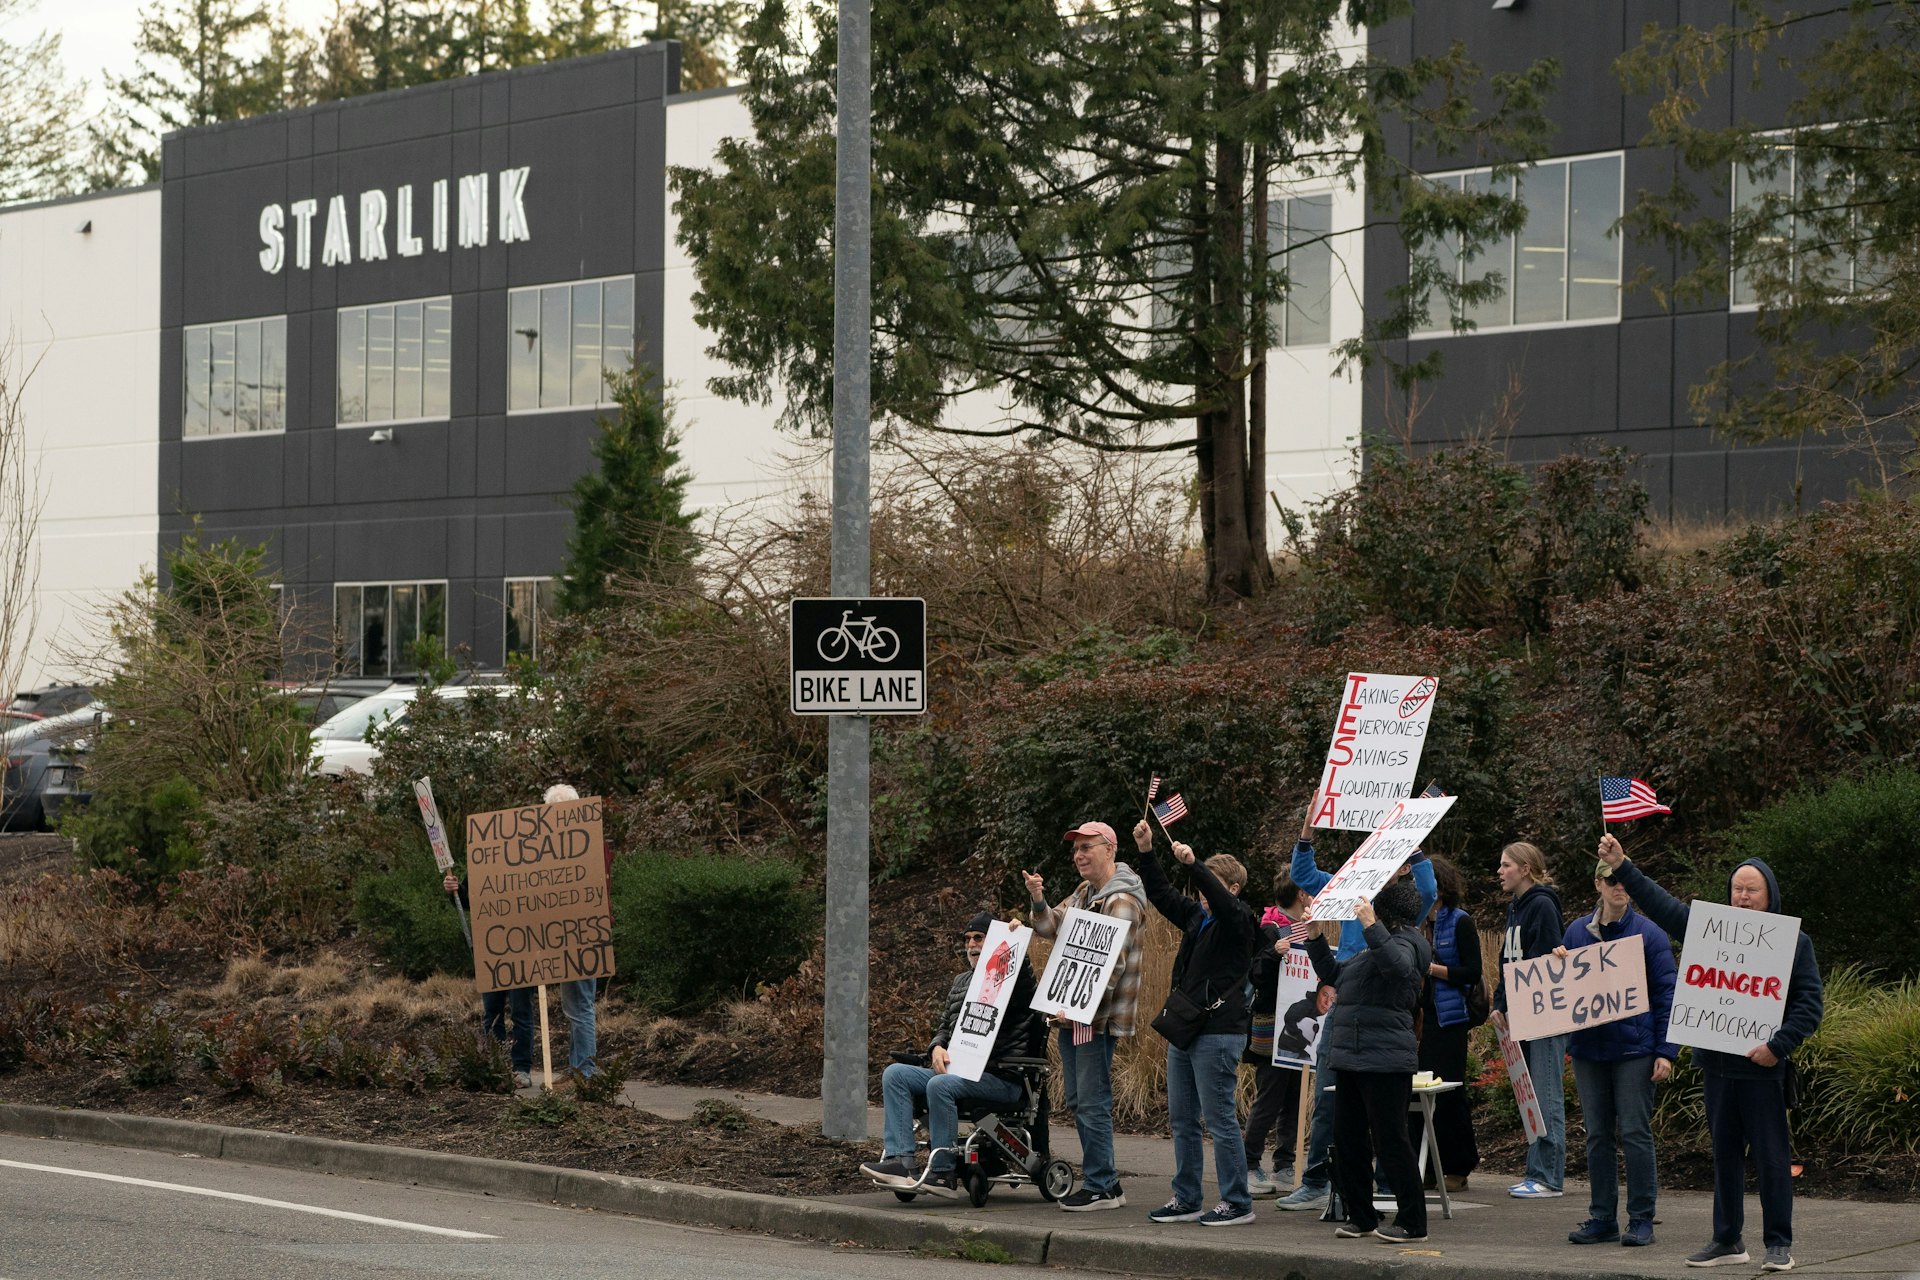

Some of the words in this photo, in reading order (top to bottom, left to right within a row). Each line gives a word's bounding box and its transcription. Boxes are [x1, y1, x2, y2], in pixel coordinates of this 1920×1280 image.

[259, 166, 530, 274] STARLINK
[800, 677, 850, 702] BIKE
[860, 677, 917, 702] LANE
[1349, 675, 1399, 704] TAKING
[1401, 679, 1434, 716] MUSK
[1337, 704, 1425, 737] EVERYONES
[1329, 737, 1409, 767] SAVINGS
[1325, 767, 1411, 798] LIQUIDATING
[468, 805, 554, 844] MUSK
[556, 802, 602, 828] HANDS
[1314, 798, 1391, 829] AMERIC
[1378, 803, 1440, 831] DIABOLICAL
[472, 846, 501, 865] OFF
[504, 829, 590, 866] USAID
[1353, 831, 1420, 860] OLIGARCH
[480, 865, 586, 896] AUTHORIZED
[1327, 859, 1391, 890] GRIFTING
[477, 900, 511, 920] AND
[517, 889, 580, 914] FUNDED
[485, 915, 613, 956] CONGRESS
[1067, 917, 1091, 945] IT'S
[1086, 923, 1119, 952] MUSK
[1702, 917, 1776, 950] MUSK
[484, 958, 528, 989] YOU
[530, 957, 563, 982] ARE
[564, 943, 613, 979] NOT
[1285, 965, 1309, 980] YOUR
[1286, 953, 1310, 967] MUSK
[1514, 943, 1618, 992] MUSK
[1716, 950, 1729, 963] is
[1736, 952, 1745, 964] a
[1047, 958, 1078, 1004] OR
[1070, 964, 1101, 1010] US
[1685, 964, 1782, 1001] DANGER
[1532, 987, 1568, 1015] BE
[1572, 987, 1638, 1025] GONE
[1719, 996, 1735, 1006] to
[1671, 1003, 1778, 1042] DEMOCRACY
